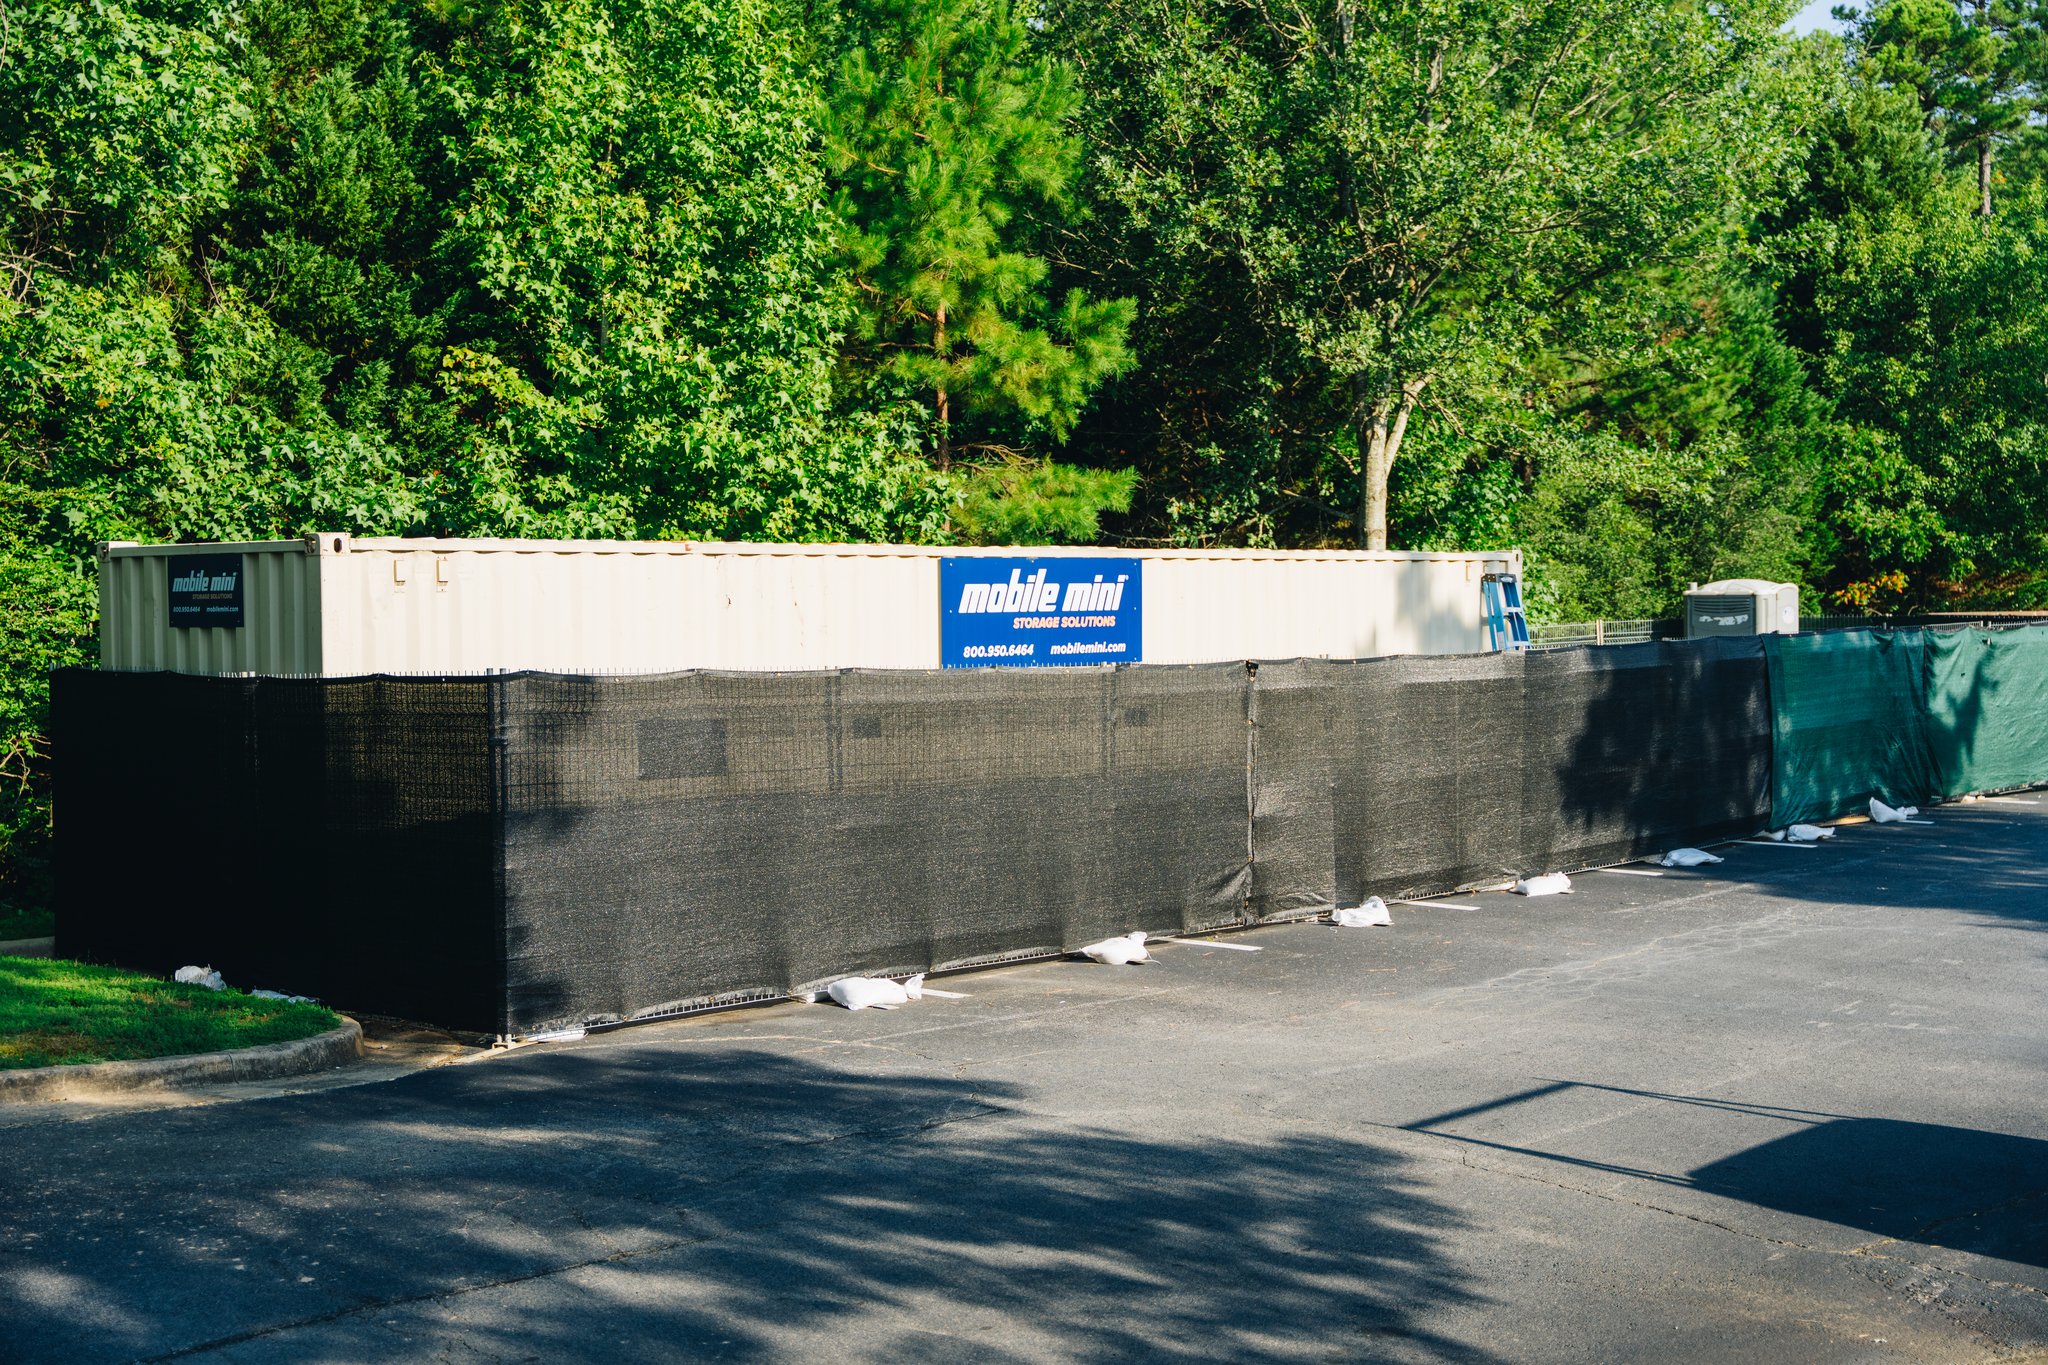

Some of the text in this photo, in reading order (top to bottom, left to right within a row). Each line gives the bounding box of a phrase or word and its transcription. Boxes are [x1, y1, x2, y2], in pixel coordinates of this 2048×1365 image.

[172, 570, 237, 592] mobile mini
[958, 568, 1127, 613] mobile mini
[1013, 615, 1116, 629] STORAGE SOLUTIONS
[963, 643, 1035, 658] 800.950.6464
[1050, 641, 1127, 655] mobilemini.com
